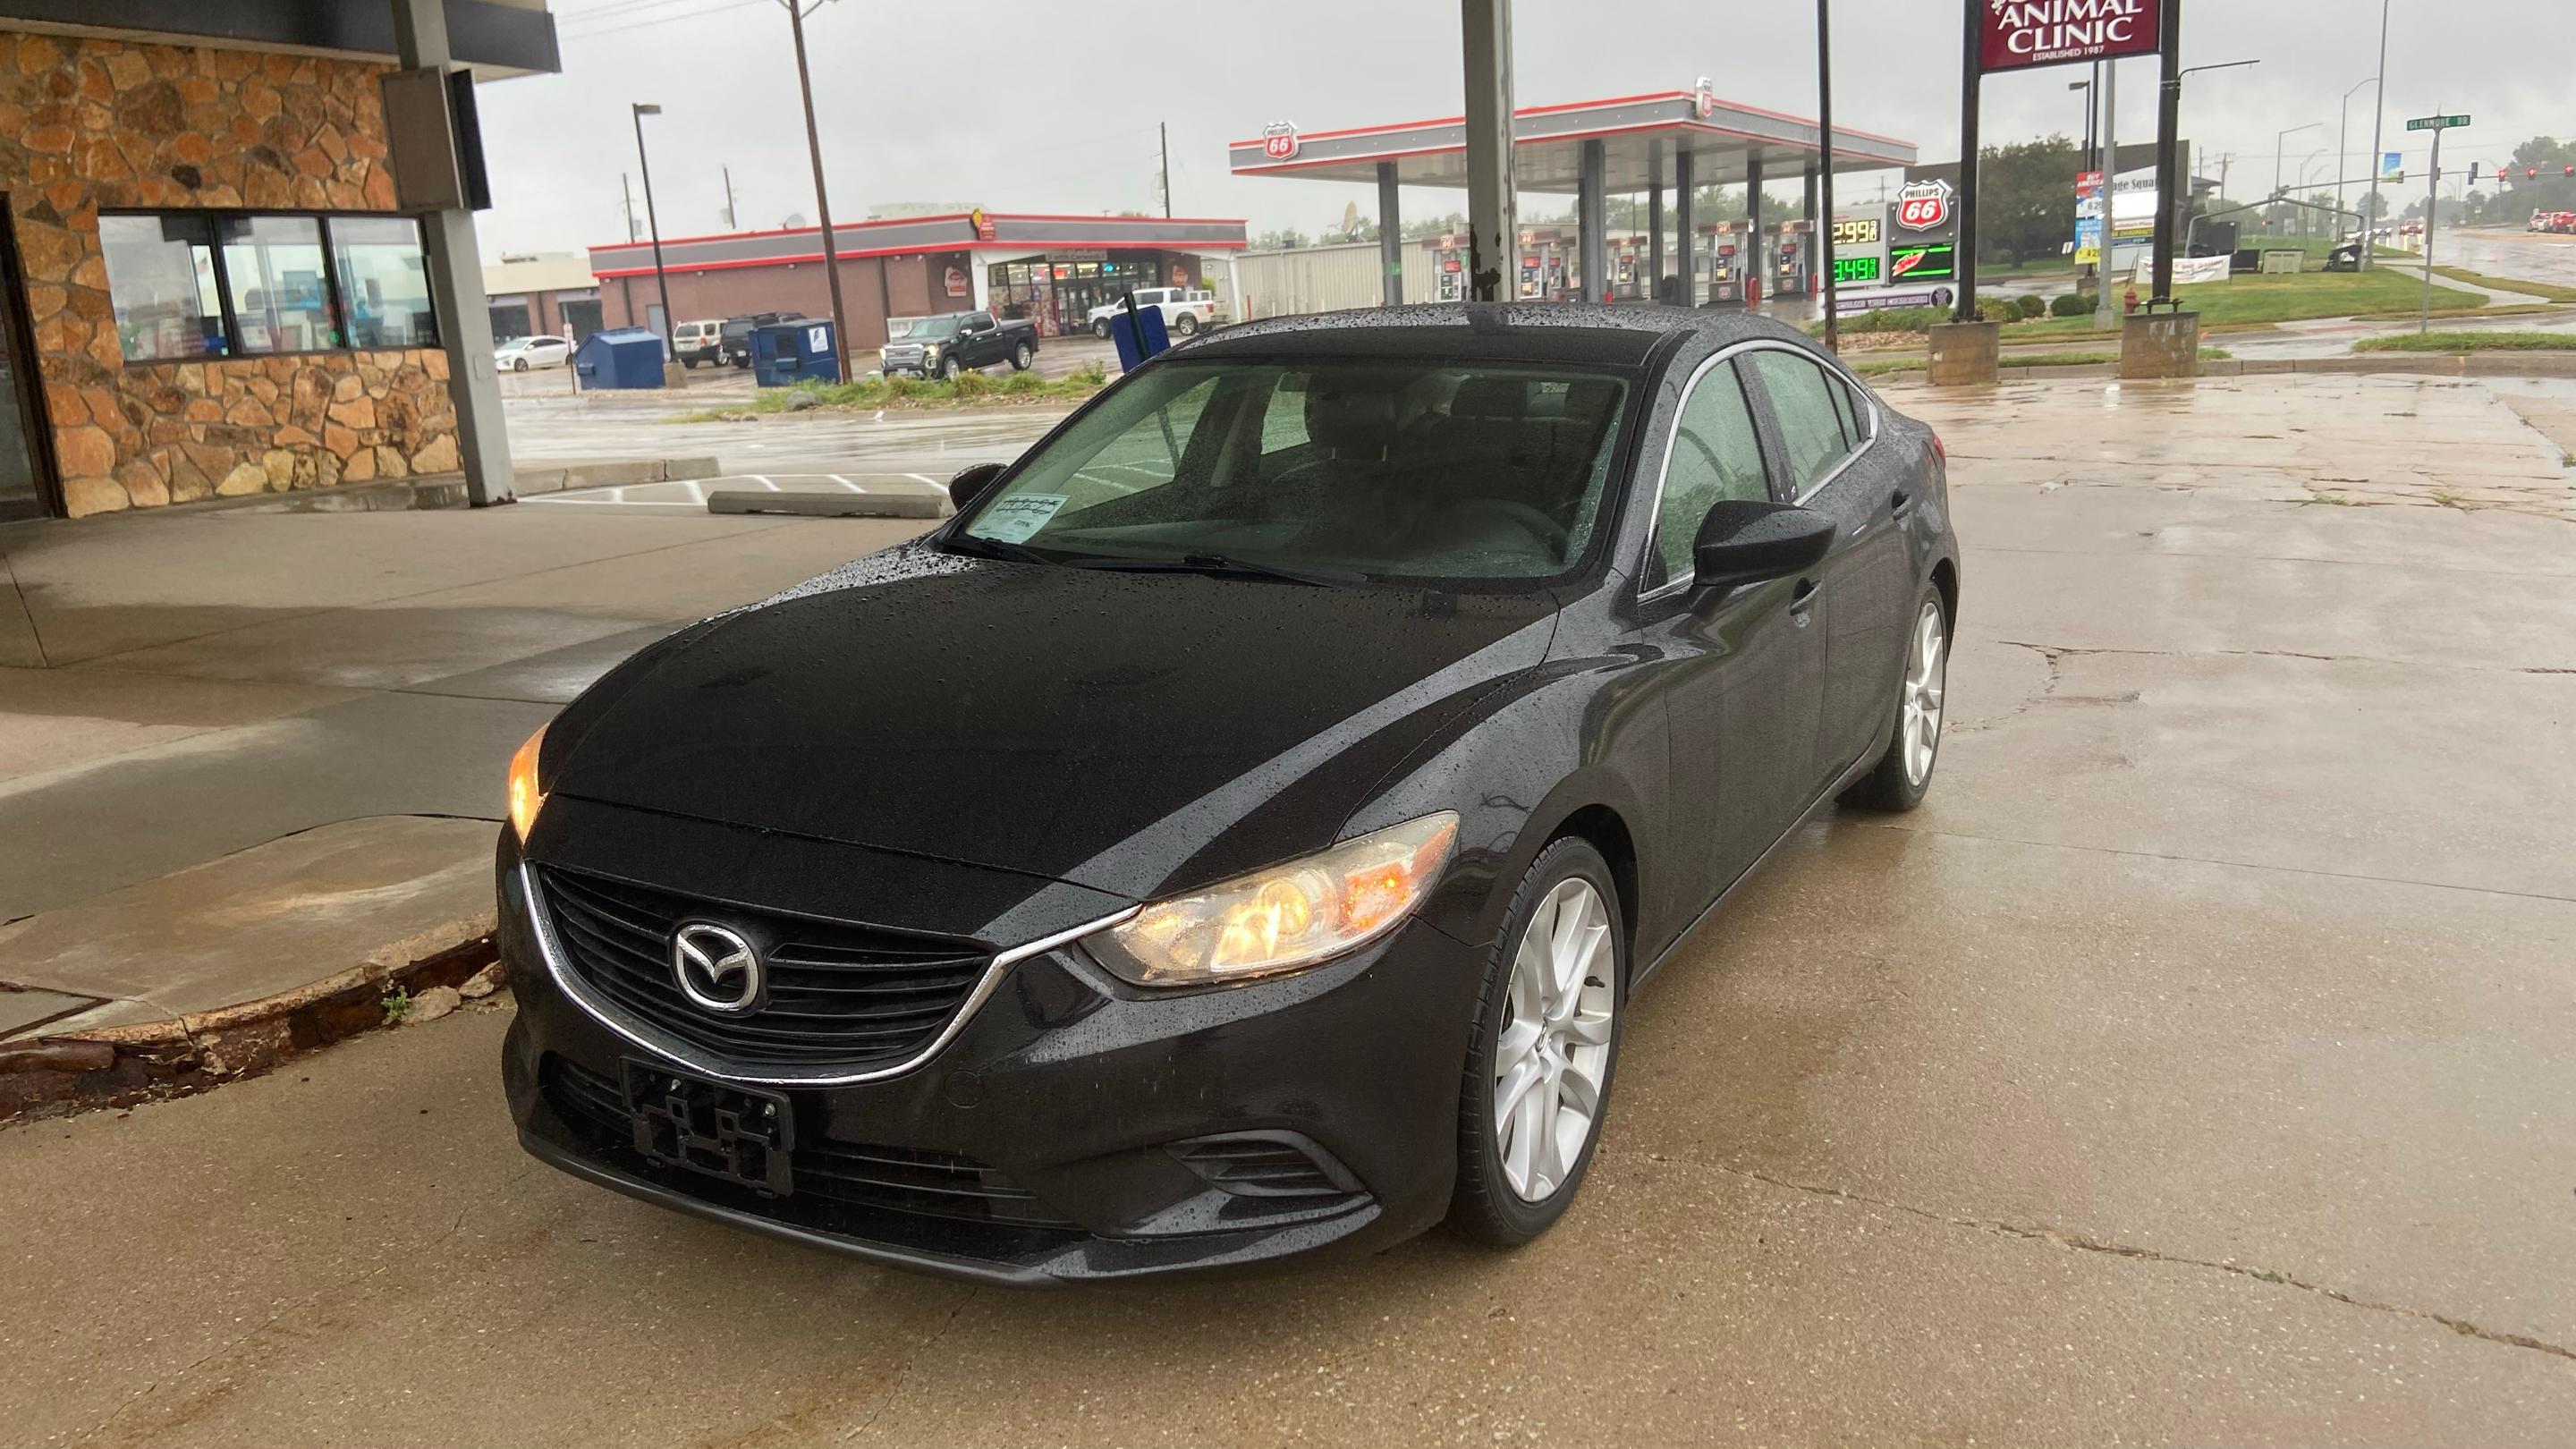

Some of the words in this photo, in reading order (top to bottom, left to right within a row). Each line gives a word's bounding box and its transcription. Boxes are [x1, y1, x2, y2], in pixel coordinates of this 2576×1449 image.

[1997, 0, 2144, 30] ANIMAL
[2007, 16, 2134, 54] CLINIC
[2032, 48, 2081, 62] ESTABLISHED
[2084, 45, 2105, 55] 1987
[2409, 117, 2449, 130] GLENMORE
[2457, 116, 2469, 126] DR
[1269, 138, 1289, 153] 66
[1905, 188, 1939, 198] PHILLIPS
[1906, 200, 1937, 221] 66
